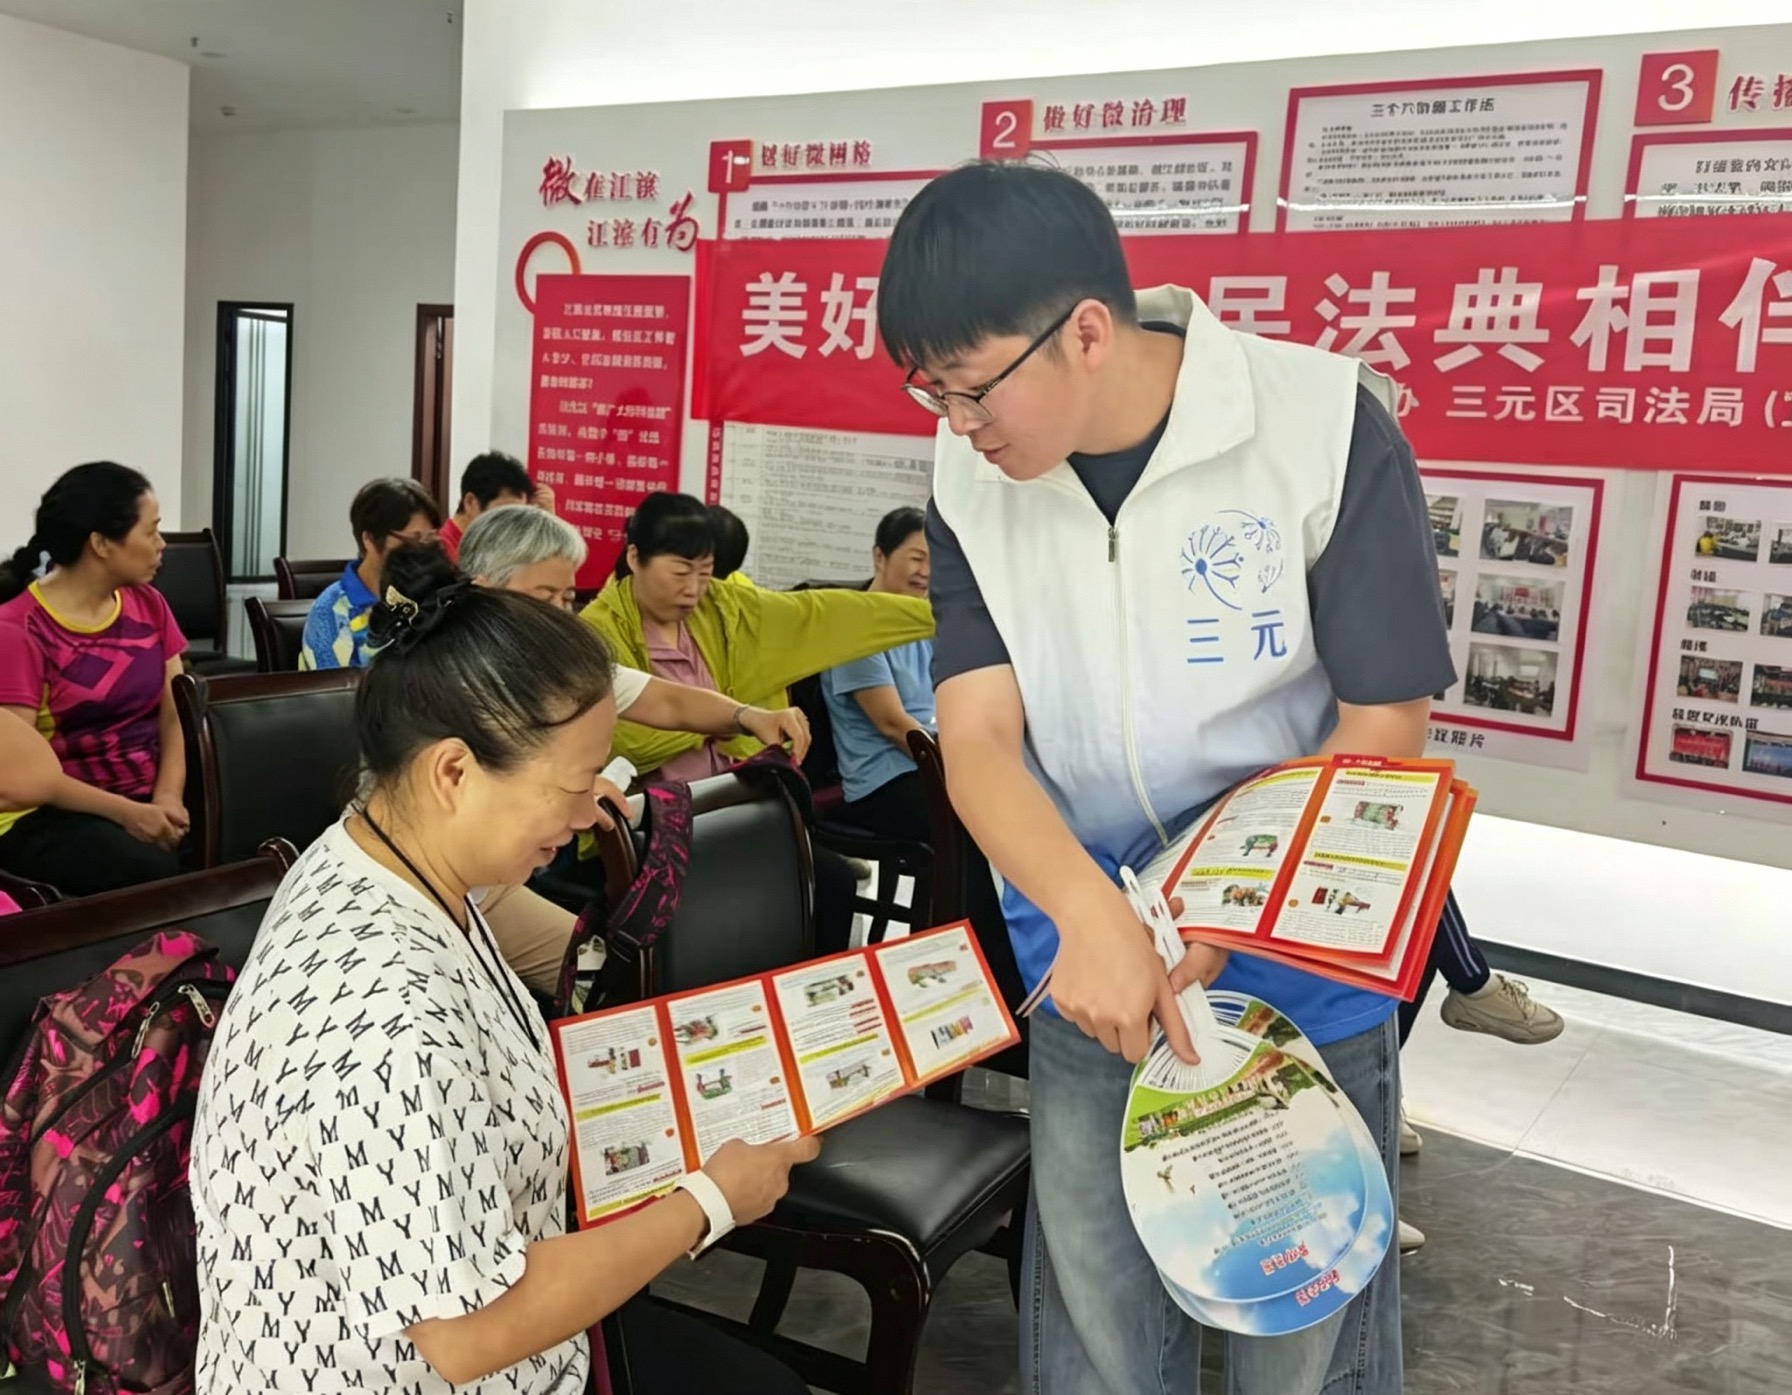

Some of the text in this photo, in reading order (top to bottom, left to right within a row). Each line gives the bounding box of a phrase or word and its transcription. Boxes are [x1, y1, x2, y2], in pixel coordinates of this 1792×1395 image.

[1658, 63, 1695, 112] 3
[992, 111, 1018, 149] 2
[1187, 609, 1288, 664] 三元
[436, 1078, 454, 1105] Y
[362, 1100, 380, 1130] Y
[452, 1106, 467, 1132] Y
[319, 1114, 340, 1146] M
[385, 1123, 406, 1153] Y
[343, 1139, 370, 1171] M
[375, 1157, 395, 1186] Y
[460, 1162, 475, 1191] Y
[328, 1174, 352, 1204] M
[402, 1179, 421, 1208] Y
[477, 1184, 499, 1214] M
[356, 1195, 386, 1227] M
[392, 1212, 412, 1240] Y
[470, 1220, 487, 1248] Y
[230, 1234, 253, 1262] M
[275, 1237, 293, 1259] Y
[344, 1230, 370, 1261] M
[253, 1258, 277, 1291] M
[375, 1249, 405, 1282] M
[410, 1269, 429, 1297] Y
[277, 1290, 296, 1317] Y
[359, 1285, 389, 1317] M
[260, 1311, 281, 1339] M
[293, 1318, 312, 1344] Y
[283, 1340, 301, 1366] Y
[314, 1343, 337, 1369] M
[394, 1339, 416, 1364] M
[300, 1367, 320, 1393] Y
